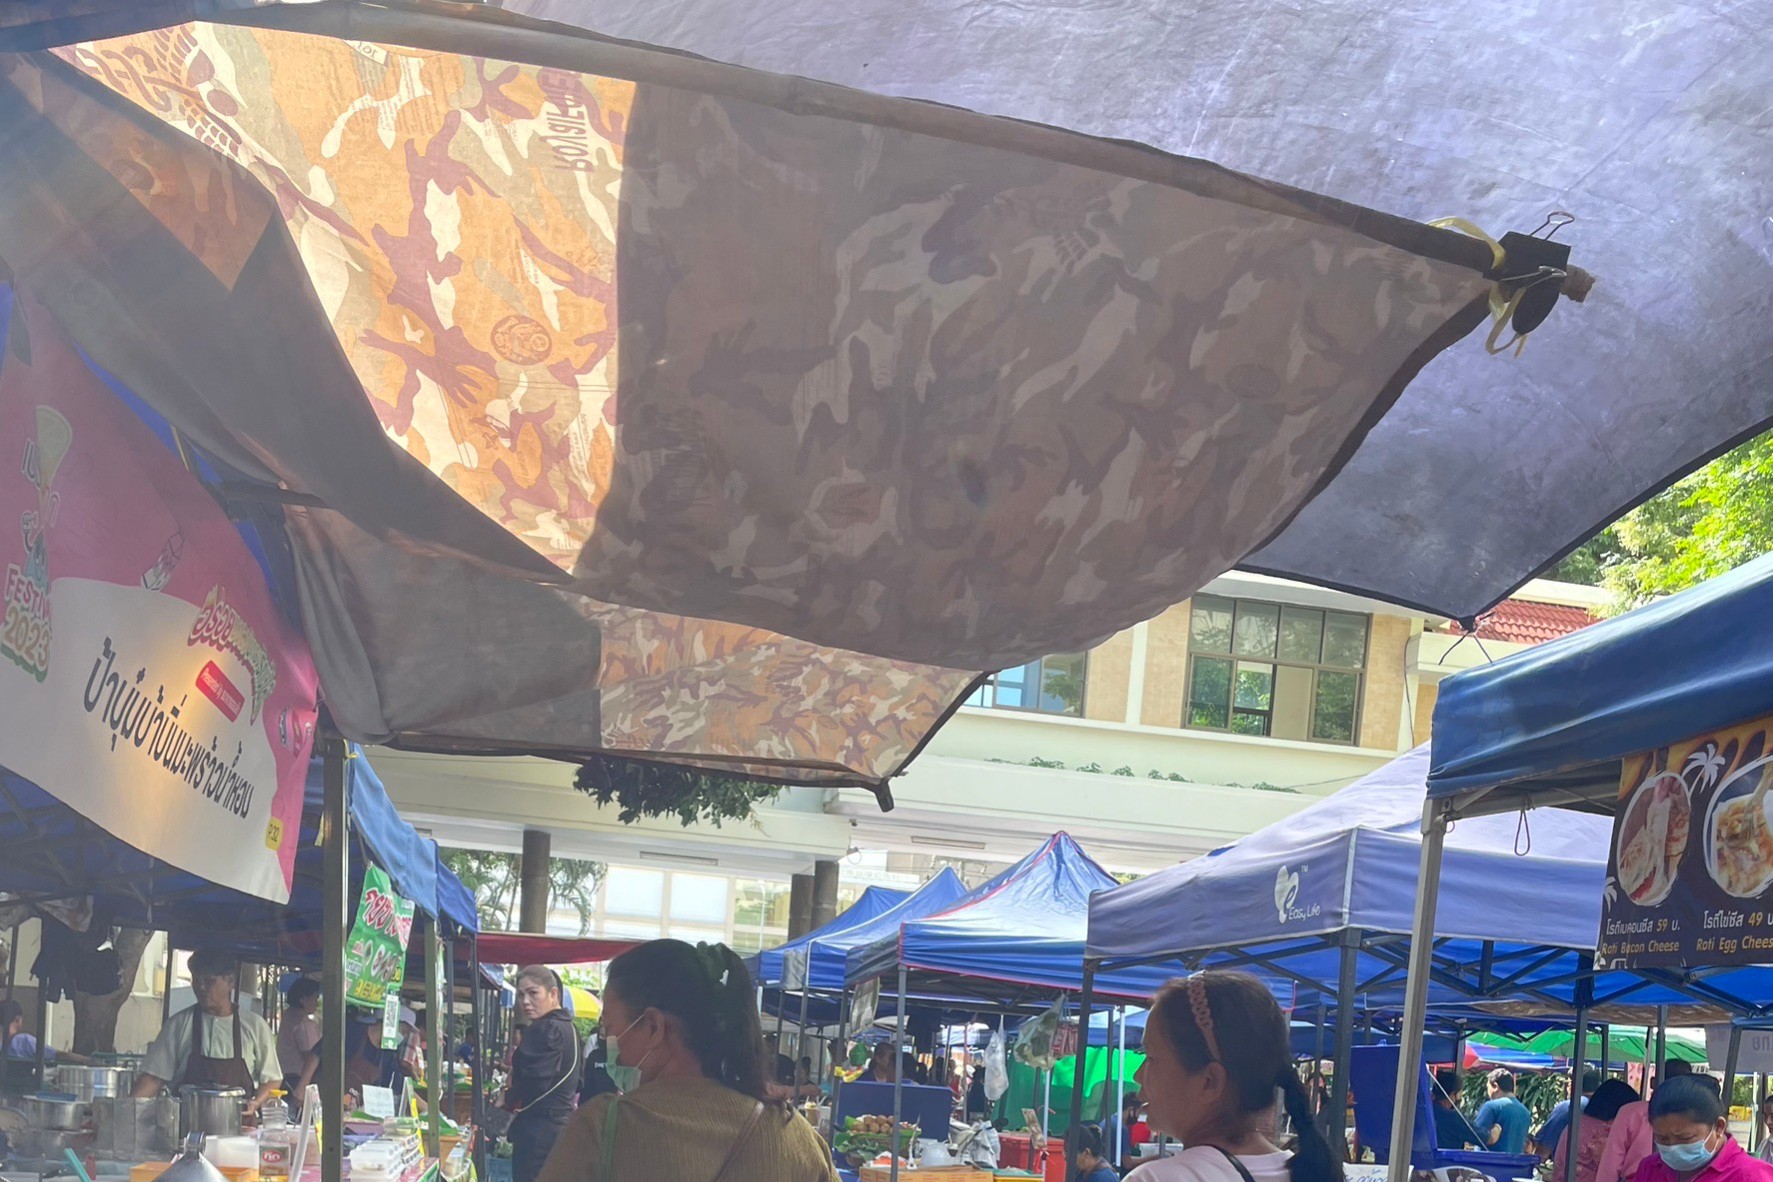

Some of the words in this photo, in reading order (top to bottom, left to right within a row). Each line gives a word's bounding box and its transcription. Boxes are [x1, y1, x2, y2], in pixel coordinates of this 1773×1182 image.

[2, 605, 51, 668] 2023
[1288, 906, 1306, 921] Easy
[1306, 903, 1321, 917] Life
[1703, 909, 1745, 929] โรตีไข่ชีส
[1748, 912, 1763, 926] 49
[1656, 918, 1668, 932] 59
[1671, 919, 1681, 932] บ.
[1602, 942, 1618, 955] Roti
[1620, 941, 1645, 954] Bacon
[1648, 940, 1680, 953] Cheese
[1696, 936, 1716, 951] Roti
[1719, 937, 1738, 954] Egg
